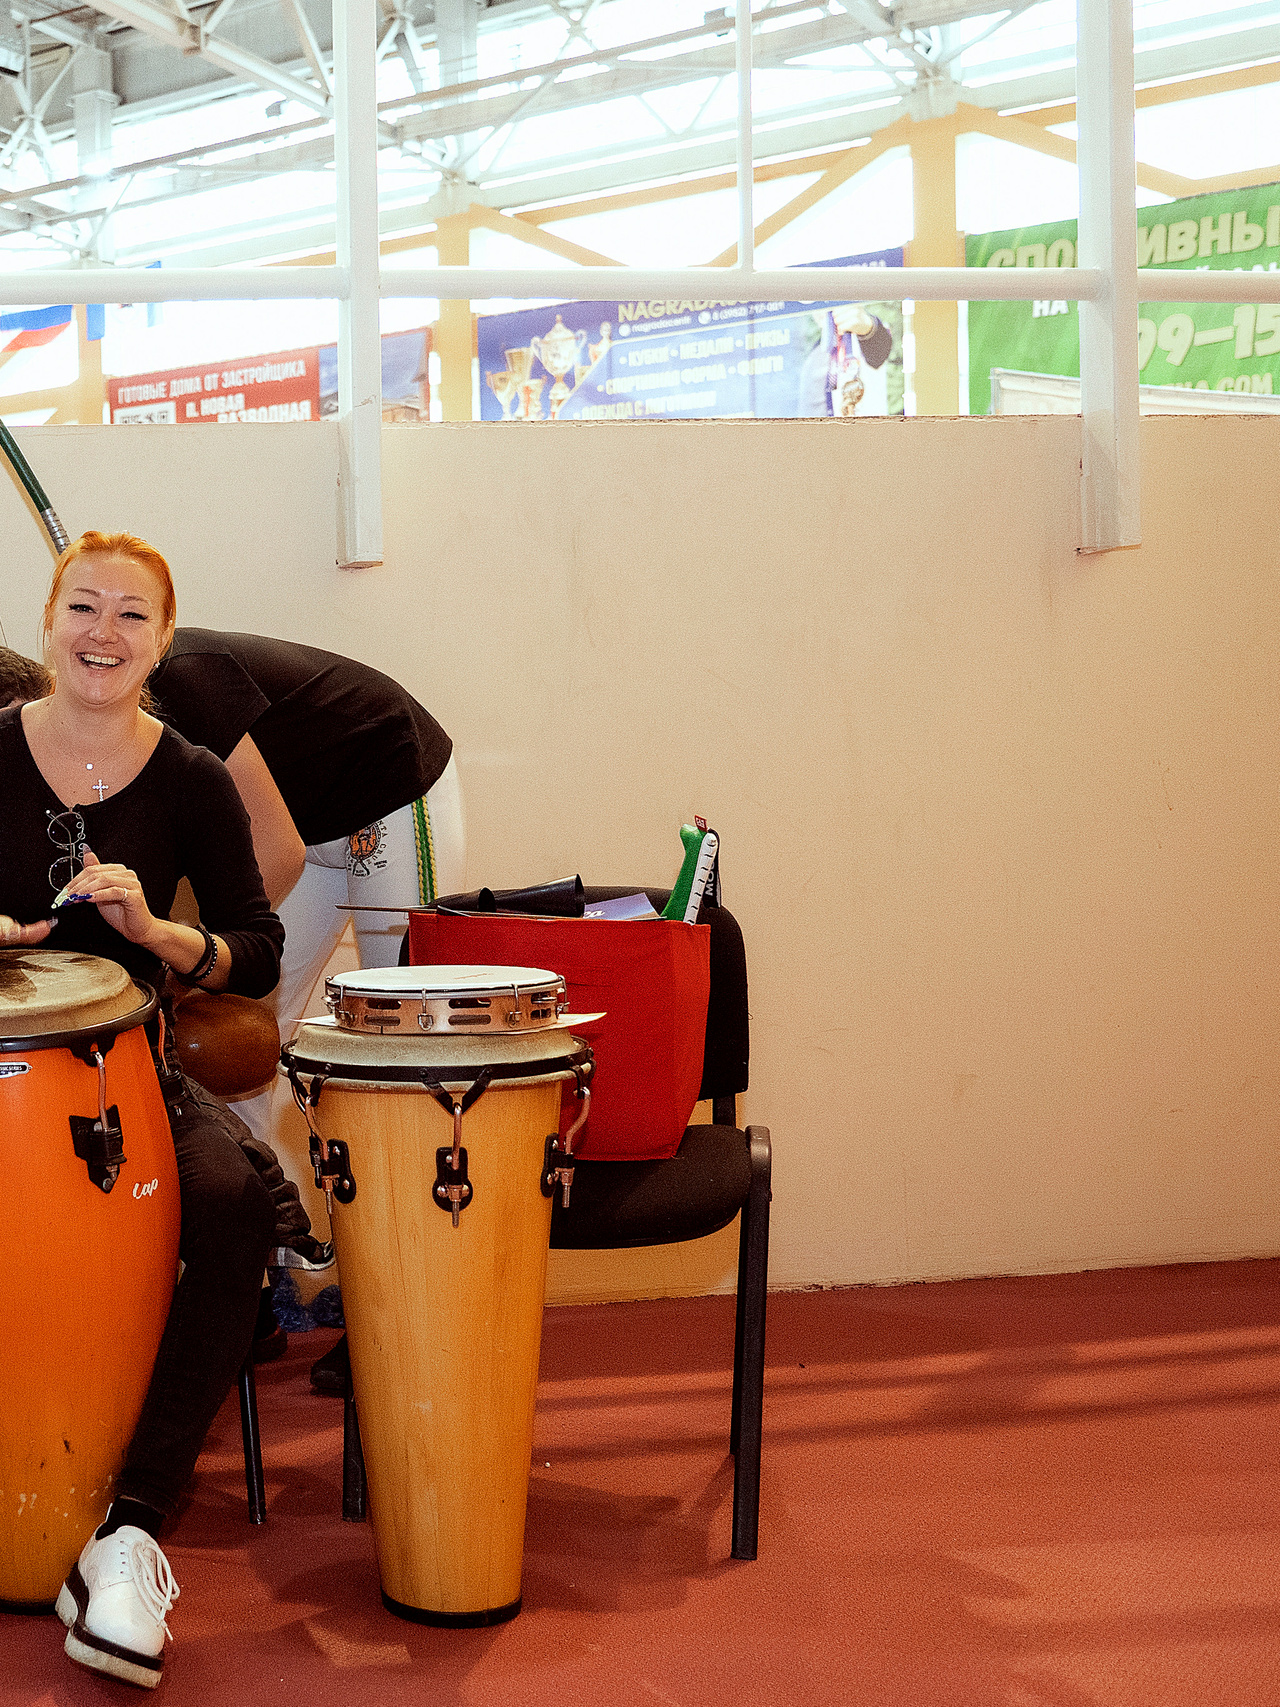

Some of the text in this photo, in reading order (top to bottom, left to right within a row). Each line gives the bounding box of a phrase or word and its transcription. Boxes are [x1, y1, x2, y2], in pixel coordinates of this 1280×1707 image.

[679, 336, 734, 359] МЕДАЛИ
[118, 360, 306, 404] ГОТОВЫЕ ДОМА ОТ ЗАСТРОЙЩИКА
[200, 392, 245, 416] НОВАЯ
